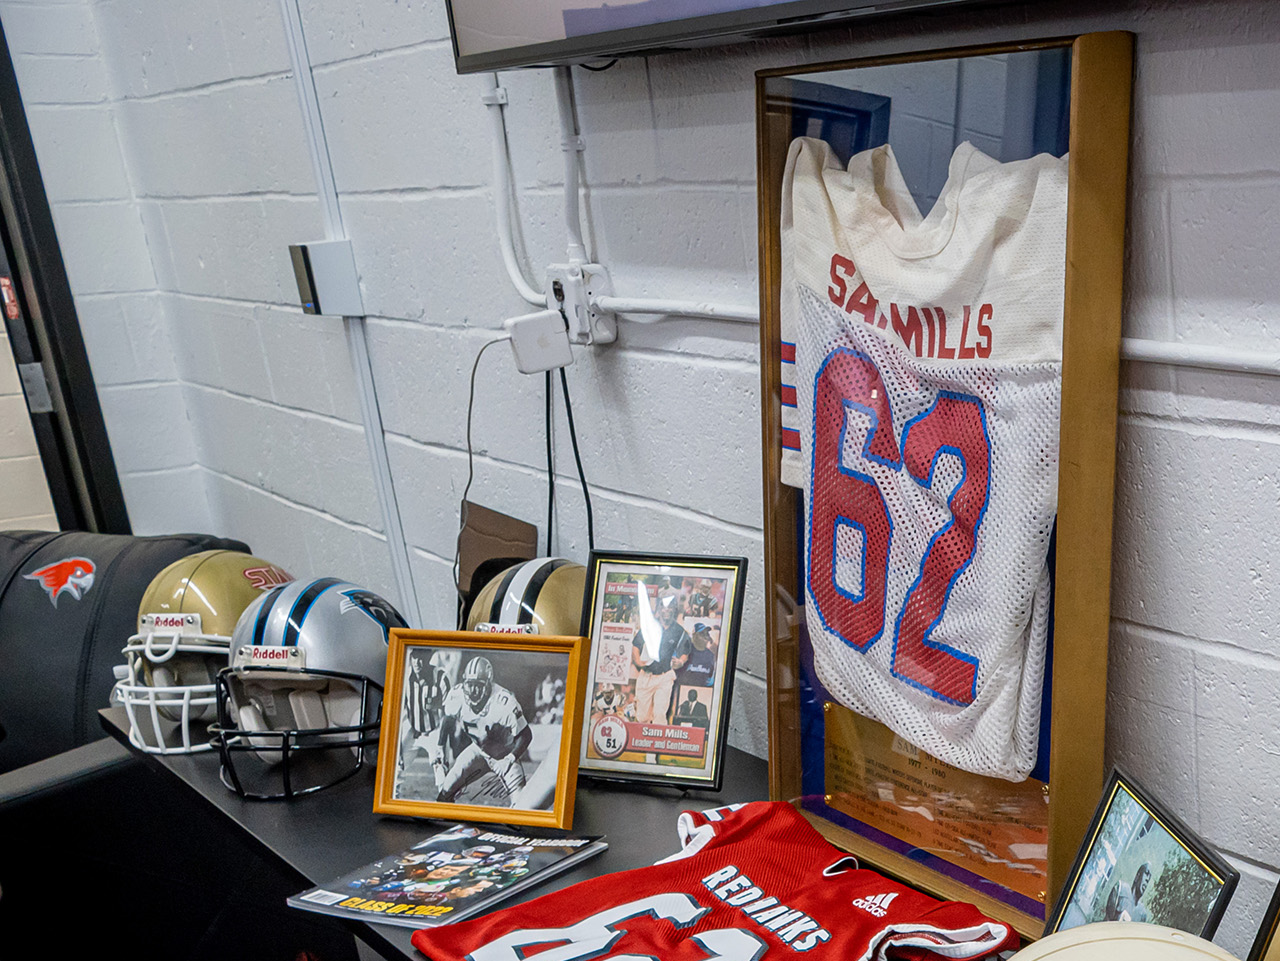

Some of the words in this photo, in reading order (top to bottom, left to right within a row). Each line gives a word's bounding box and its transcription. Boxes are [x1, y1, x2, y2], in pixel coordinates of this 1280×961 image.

[828, 253, 888, 330] SA
[807, 346, 991, 707] 62
[252, 647, 289, 660] Riddell
[642, 727, 663, 738] Sam
[606, 738, 617, 749] 51
[631, 738, 654, 749] Leader
[666, 740, 701, 753] Gentleman
[898, 740, 918, 756] SAM
[339, 896, 396, 912] CLASS
[391, 902, 411, 914] OF
[405, 904, 455, 917] 2022
[701, 865, 833, 953] REDHAWKS
[852, 897, 887, 919] adidas
